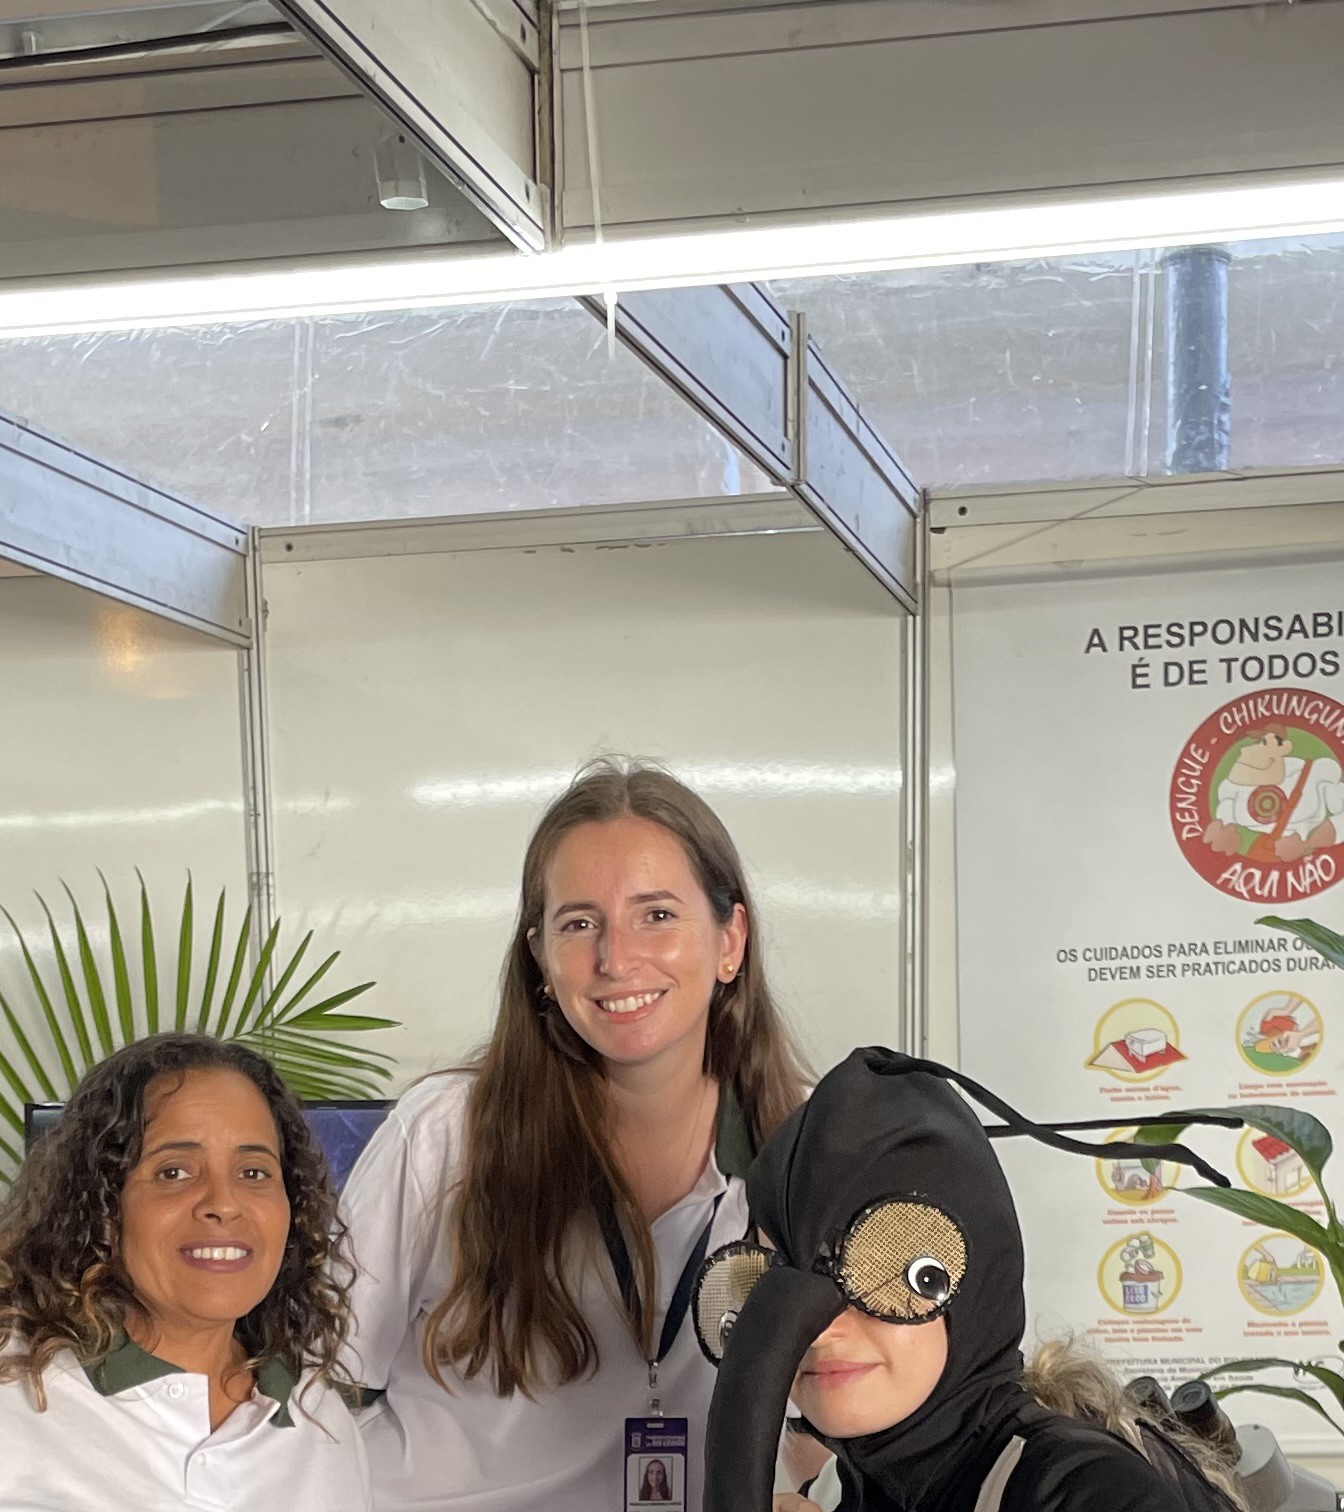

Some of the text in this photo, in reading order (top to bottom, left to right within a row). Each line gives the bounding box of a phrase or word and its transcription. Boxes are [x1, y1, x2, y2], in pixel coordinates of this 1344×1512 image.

[1084, 628, 1109, 654] A
[1130, 657, 1151, 689] É
[1162, 659, 1208, 688] DE
[1219, 650, 1340, 683] TODOS
[1175, 743, 1210, 841] DENGUE
[1216, 854, 1336, 899] AQUI NÃO
[1056, 949, 1078, 963] OS
[1082, 944, 1163, 962] CUIDADOS
[1167, 941, 1210, 958] PARA
[1213, 937, 1288, 956] ELIMINAR
[1088, 966, 1141, 982] DEVEM
[1146, 964, 1177, 979] SER
[1181, 958, 1281, 978] PRATICADOS
